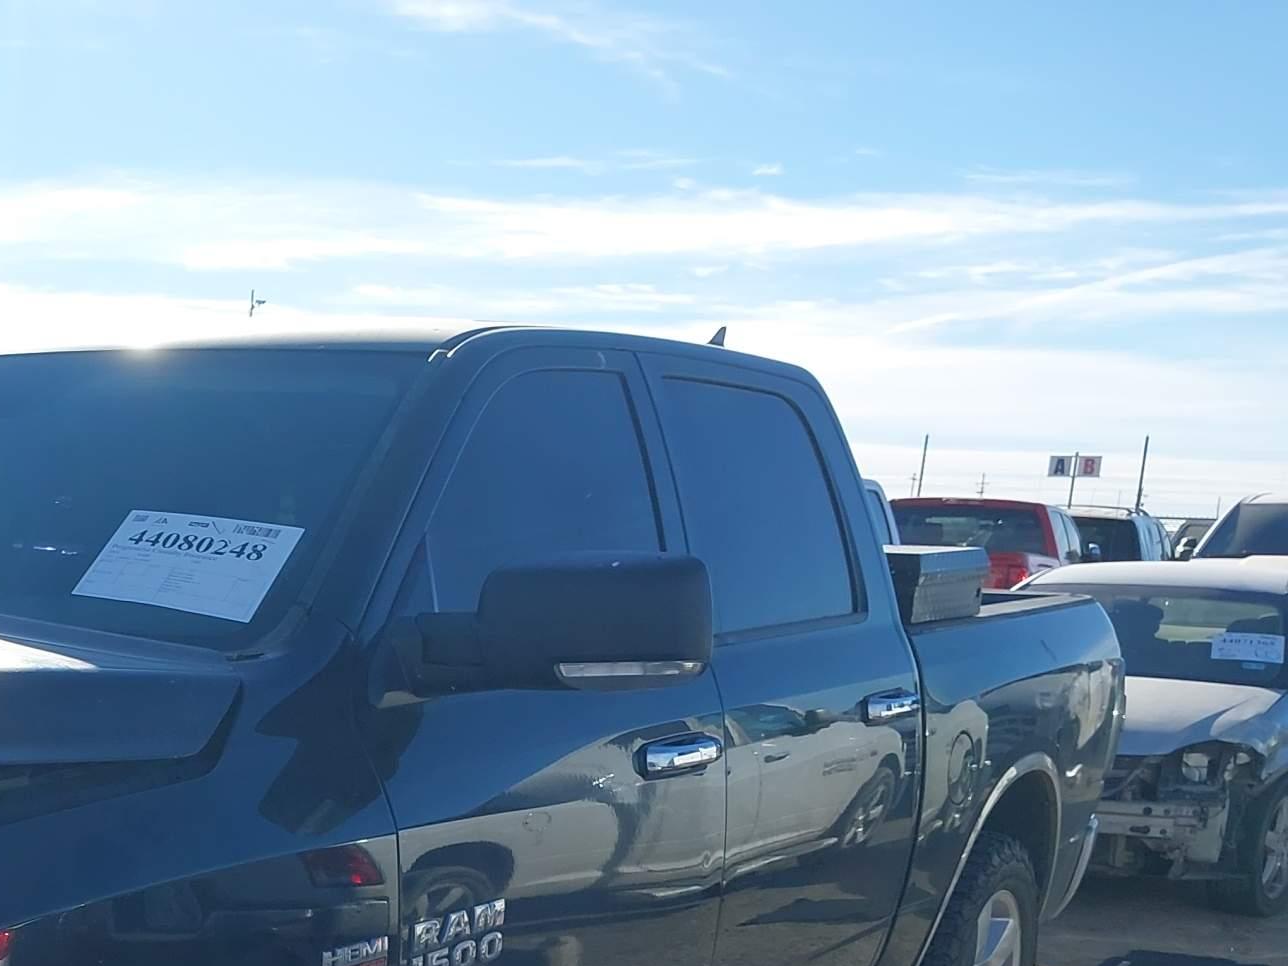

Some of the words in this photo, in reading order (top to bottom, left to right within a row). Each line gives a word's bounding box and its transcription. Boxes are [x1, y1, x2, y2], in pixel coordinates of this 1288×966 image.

[1054, 458, 1065, 475] A
[1083, 458, 1096, 475] B
[128, 529, 267, 561] 44080248
[414, 898, 505, 948] RAM
